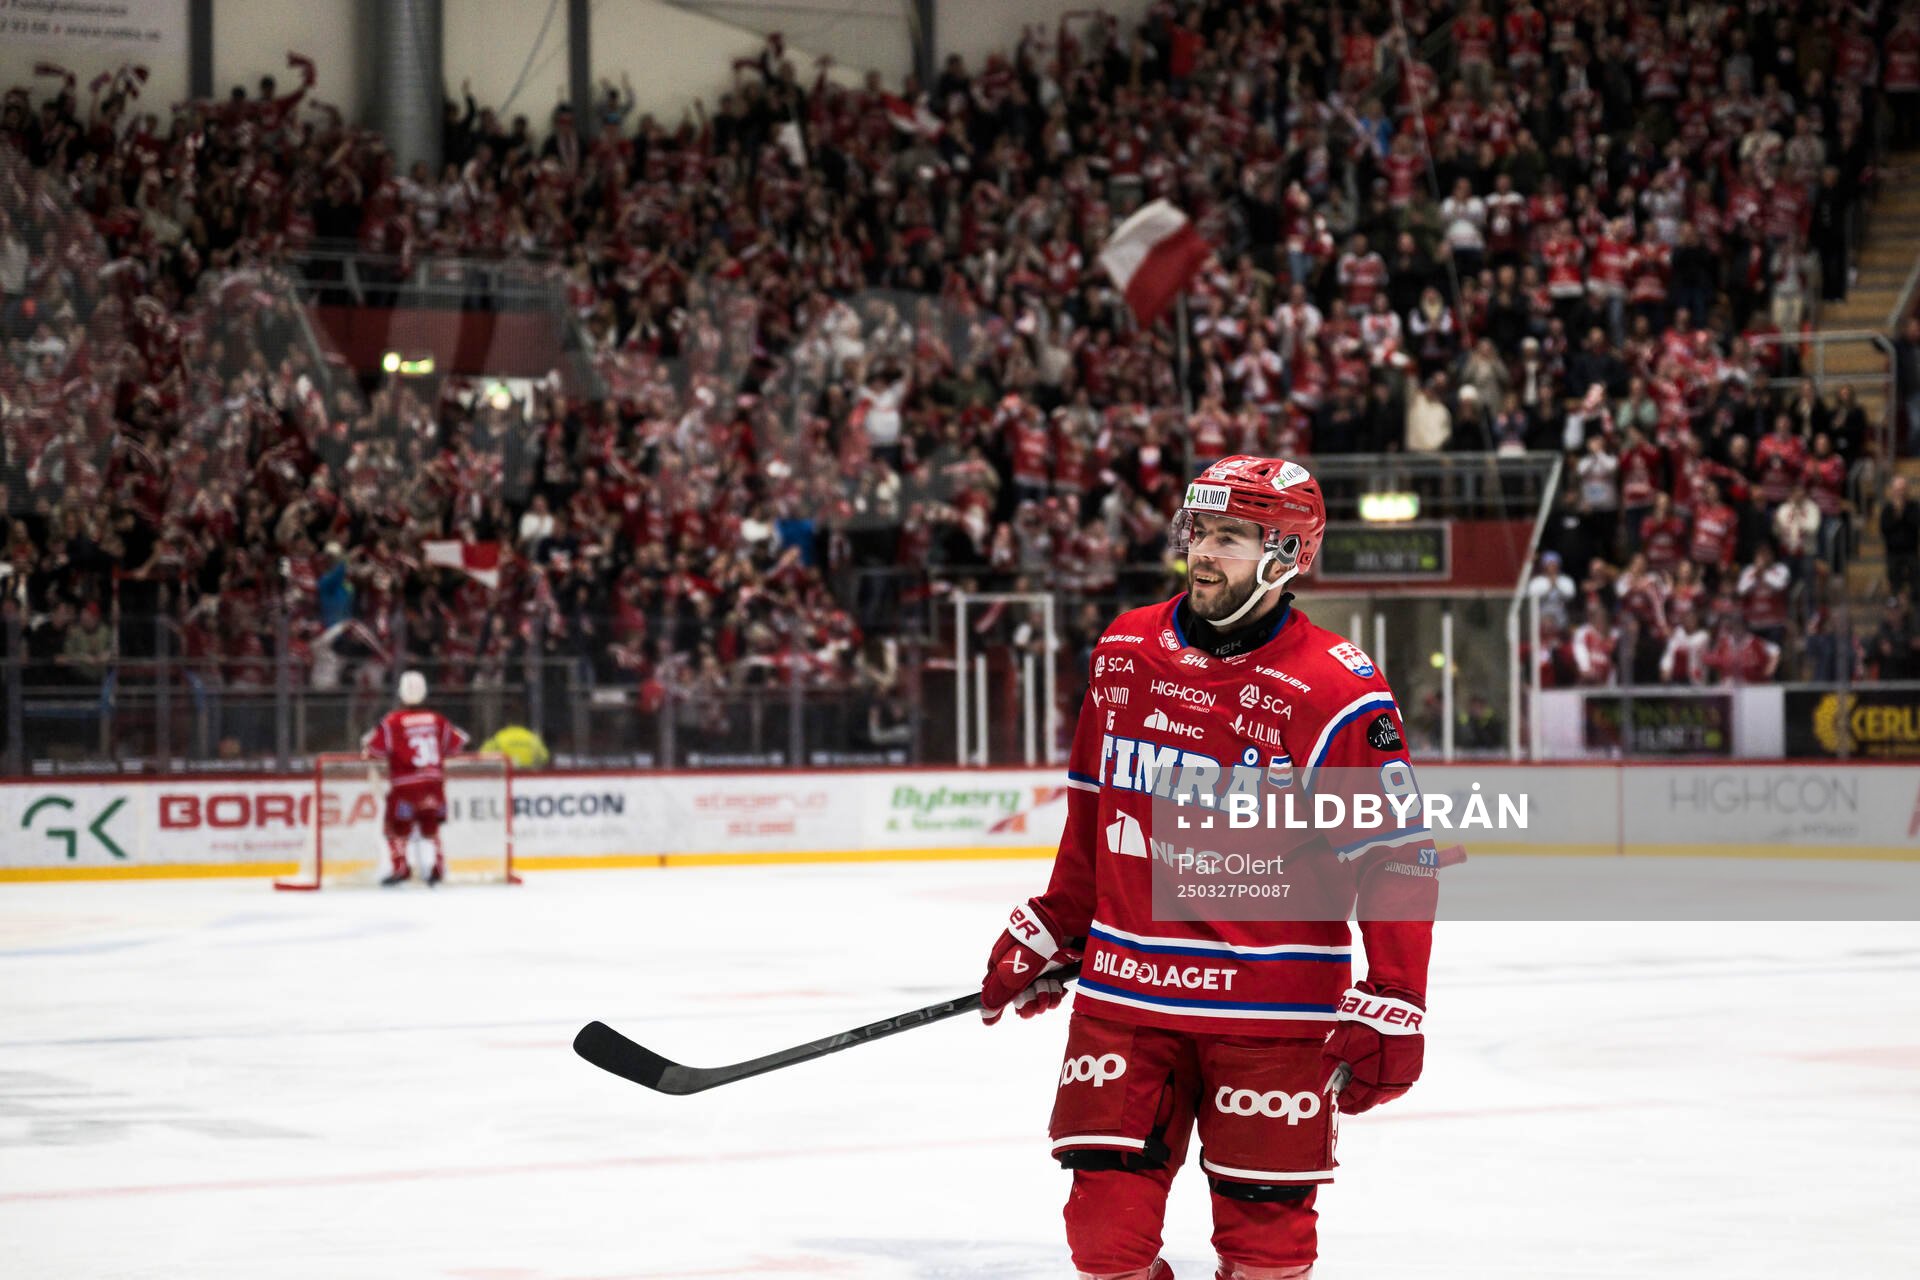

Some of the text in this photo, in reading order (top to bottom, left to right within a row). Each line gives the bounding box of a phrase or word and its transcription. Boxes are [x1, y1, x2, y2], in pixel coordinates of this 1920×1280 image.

[1196, 488, 1228, 506] LILIUM
[1107, 657, 1135, 674] SCA
[1179, 653, 1209, 669] SHL
[1150, 679, 1217, 707] HIGHCON
[1261, 694, 1292, 720] SCA
[1168, 720, 1205, 740] NHC
[1669, 773, 1859, 814] HIGHCON
[1419, 848, 1437, 866] ST
[1384, 861, 1434, 878] SUNDSVALLS
[1093, 950, 1238, 991] BILBOLAGET
[1215, 1085, 1321, 1125] coop
